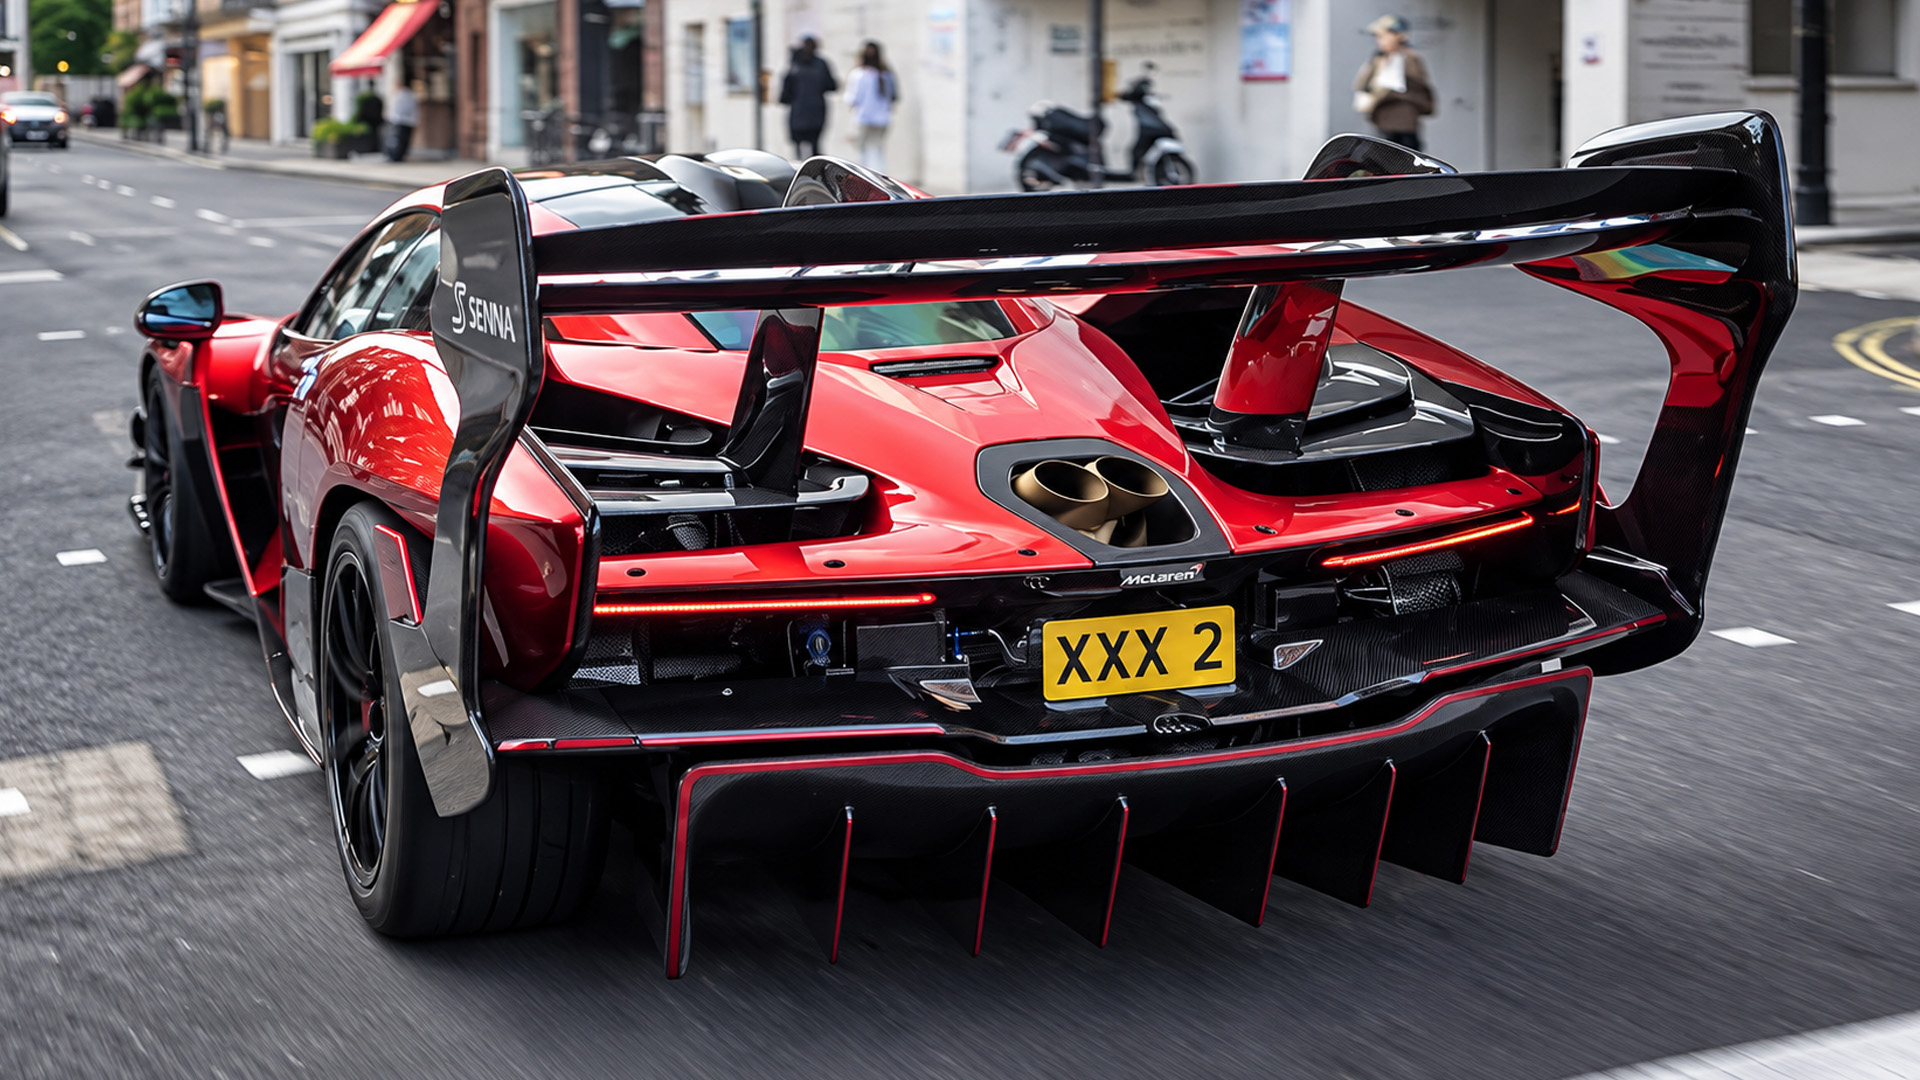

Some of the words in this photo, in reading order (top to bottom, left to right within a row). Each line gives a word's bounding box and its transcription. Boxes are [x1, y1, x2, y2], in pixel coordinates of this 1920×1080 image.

[468, 296, 516, 343] SENNA
[1120, 571, 1195, 587] McLaren
[1056, 626, 1169, 685] XXX
[1193, 621, 1222, 671] 2
